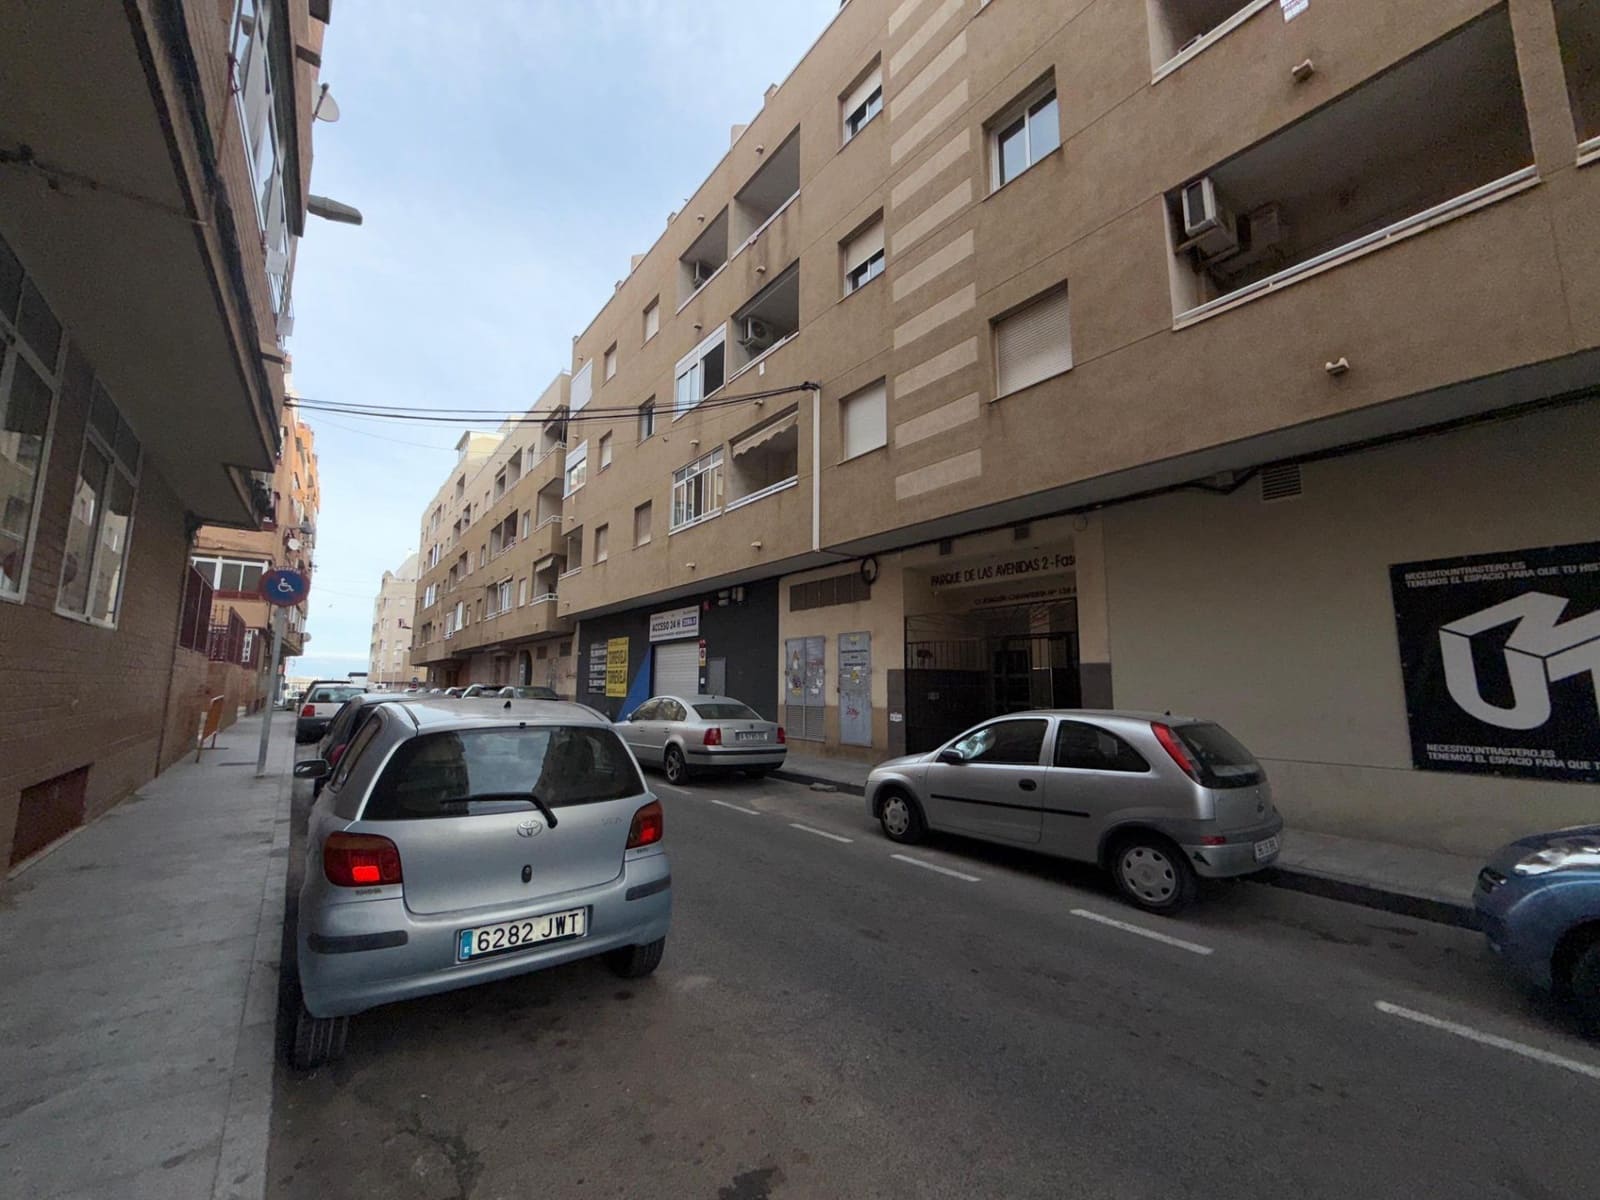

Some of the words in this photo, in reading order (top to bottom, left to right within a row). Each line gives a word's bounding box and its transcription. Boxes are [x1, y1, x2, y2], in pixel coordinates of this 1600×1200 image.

[931, 572, 962, 587] PARQUE
[964, 570, 976, 582] DE
[977, 566, 994, 580] LAS
[995, 558, 1040, 577] AVENIDAS
[1406, 576, 1447, 588] TENEMOS
[1450, 575, 1463, 585] EL
[1464, 571, 1506, 584] ESPACIO
[1507, 569, 1535, 581] PARA
[1537, 566, 1560, 577] QUE
[1561, 564, 1578, 575] TU
[1426, 743, 1556, 759] NECESITOUNTRASTERO.ES
[1428, 752, 1473, 763] TENEMOS
[1474, 753, 1488, 764] EL
[1489, 754, 1533, 767] ESPACIO
[1535, 757, 1566, 769] PARA
[1567, 759, 1591, 770] QUE
[477, 922, 534, 952] 6282
[541, 912, 579, 939] JWT
